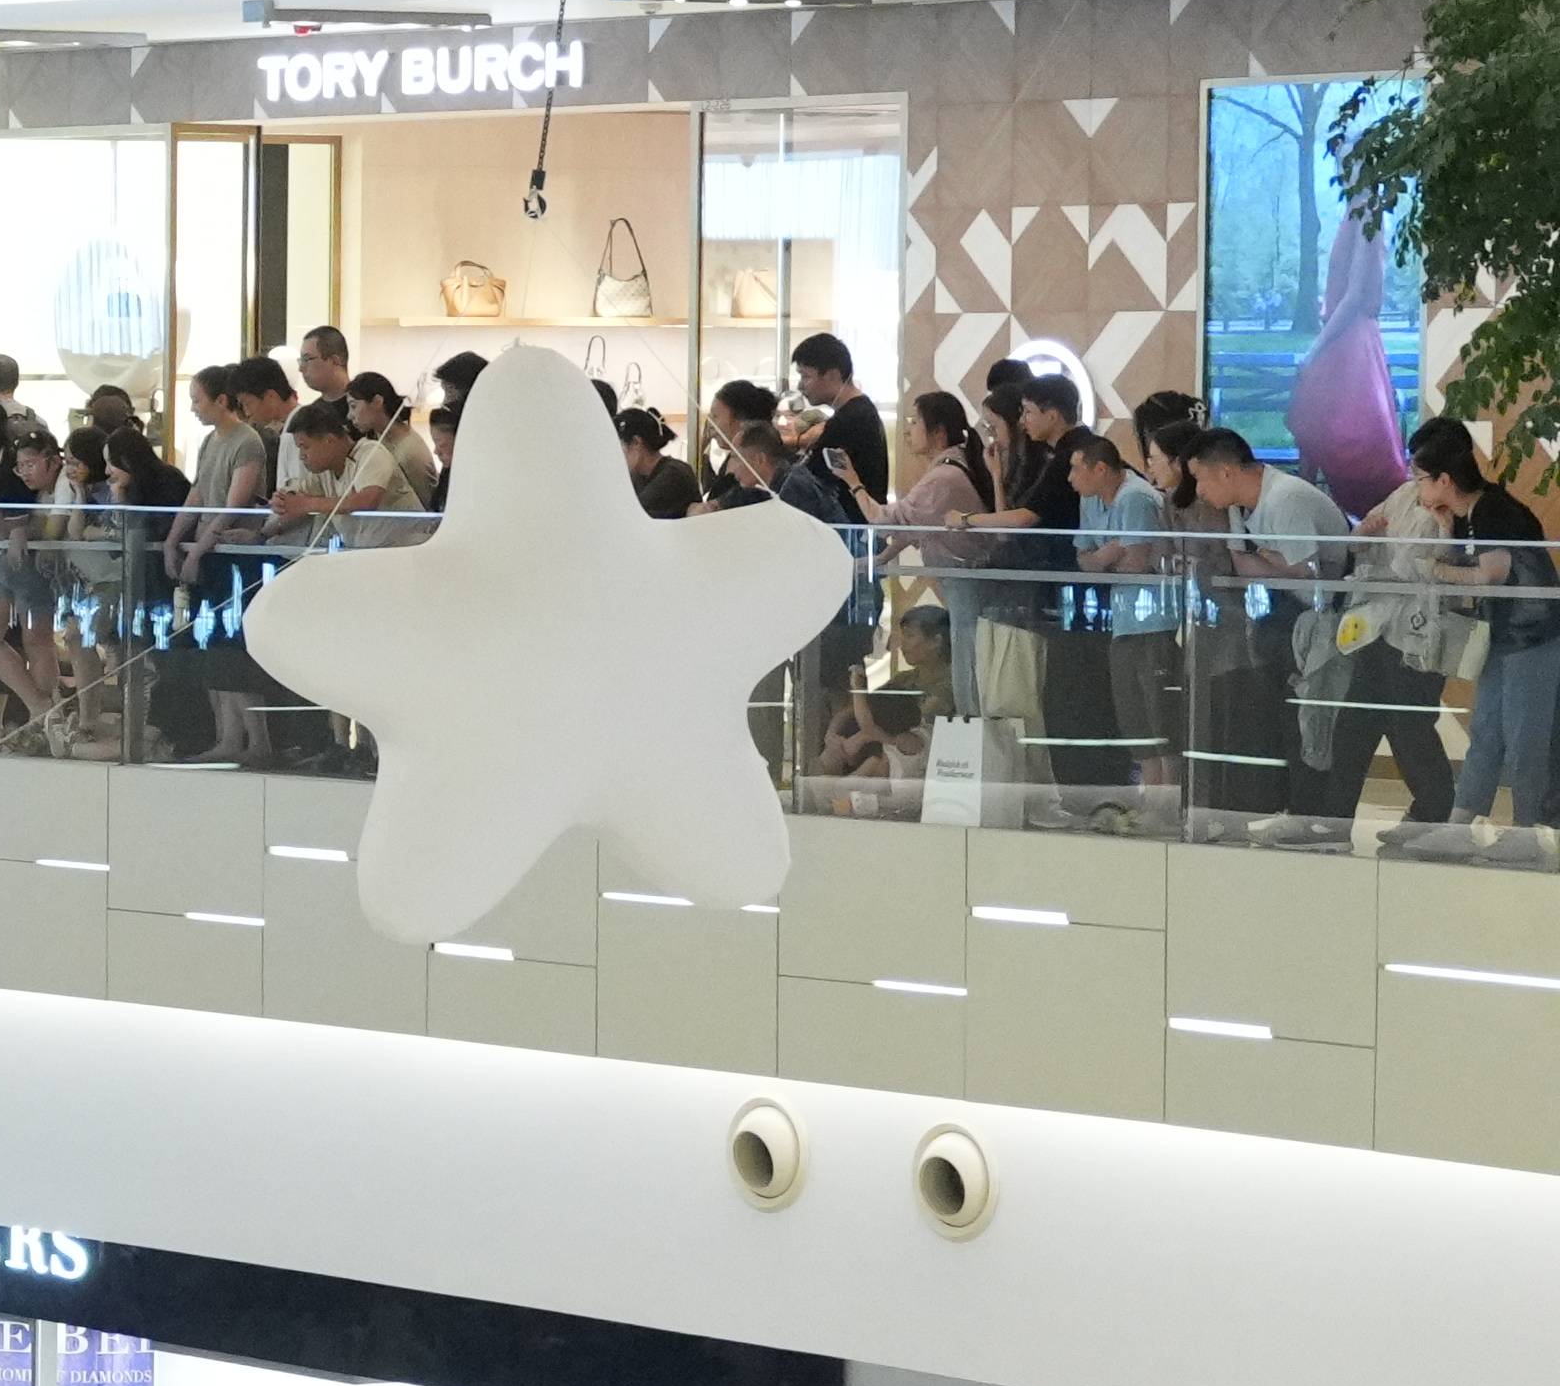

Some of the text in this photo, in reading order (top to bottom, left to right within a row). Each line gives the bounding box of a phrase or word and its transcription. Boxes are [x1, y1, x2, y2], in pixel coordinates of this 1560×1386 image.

[257, 39, 584, 102] TORY BURCH
[71, 1368, 152, 1384] DIAMONDS
